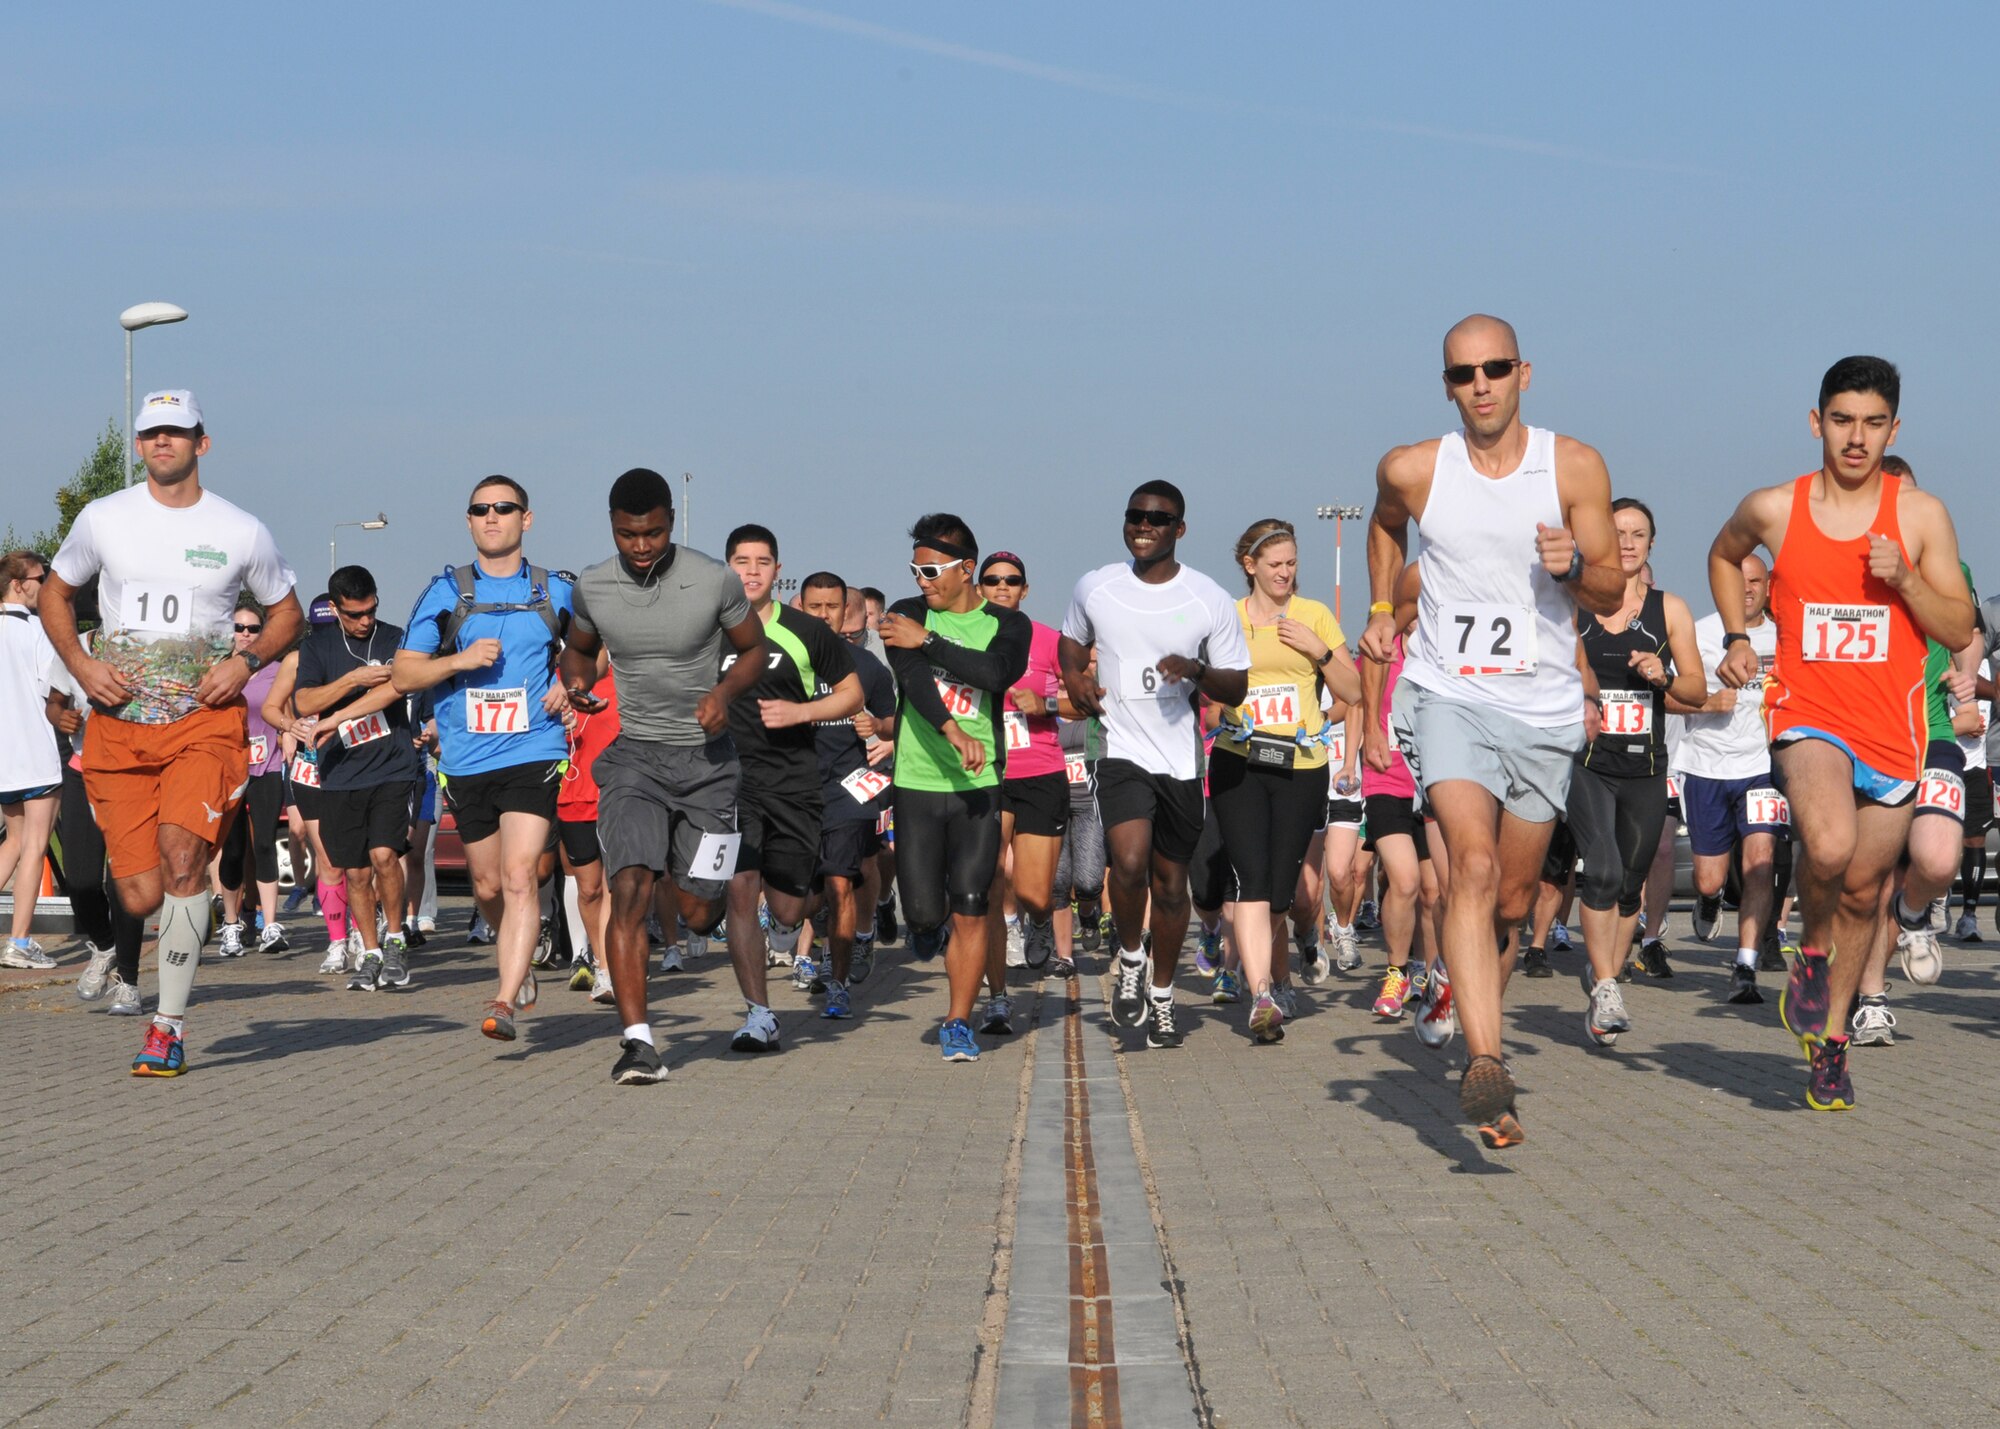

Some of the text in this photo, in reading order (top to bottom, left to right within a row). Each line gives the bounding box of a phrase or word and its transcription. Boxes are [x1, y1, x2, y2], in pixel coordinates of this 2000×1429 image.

[137, 592, 179, 624] 10
[1454, 615, 1512, 656] 72
[1815, 621, 1877, 660] 125
[1142, 666, 1156, 693] 6
[936, 680, 974, 715] 46
[1252, 696, 1293, 725] 144
[1600, 692, 1611, 700] ALF
[346, 715, 383, 745] 194
[475, 702, 519, 732] 177
[1601, 703, 1645, 733] 113
[1066, 762, 1084, 782] 02
[1916, 780, 1961, 812] 129
[1756, 799, 1788, 824] 136
[713, 844, 727, 872] 5
